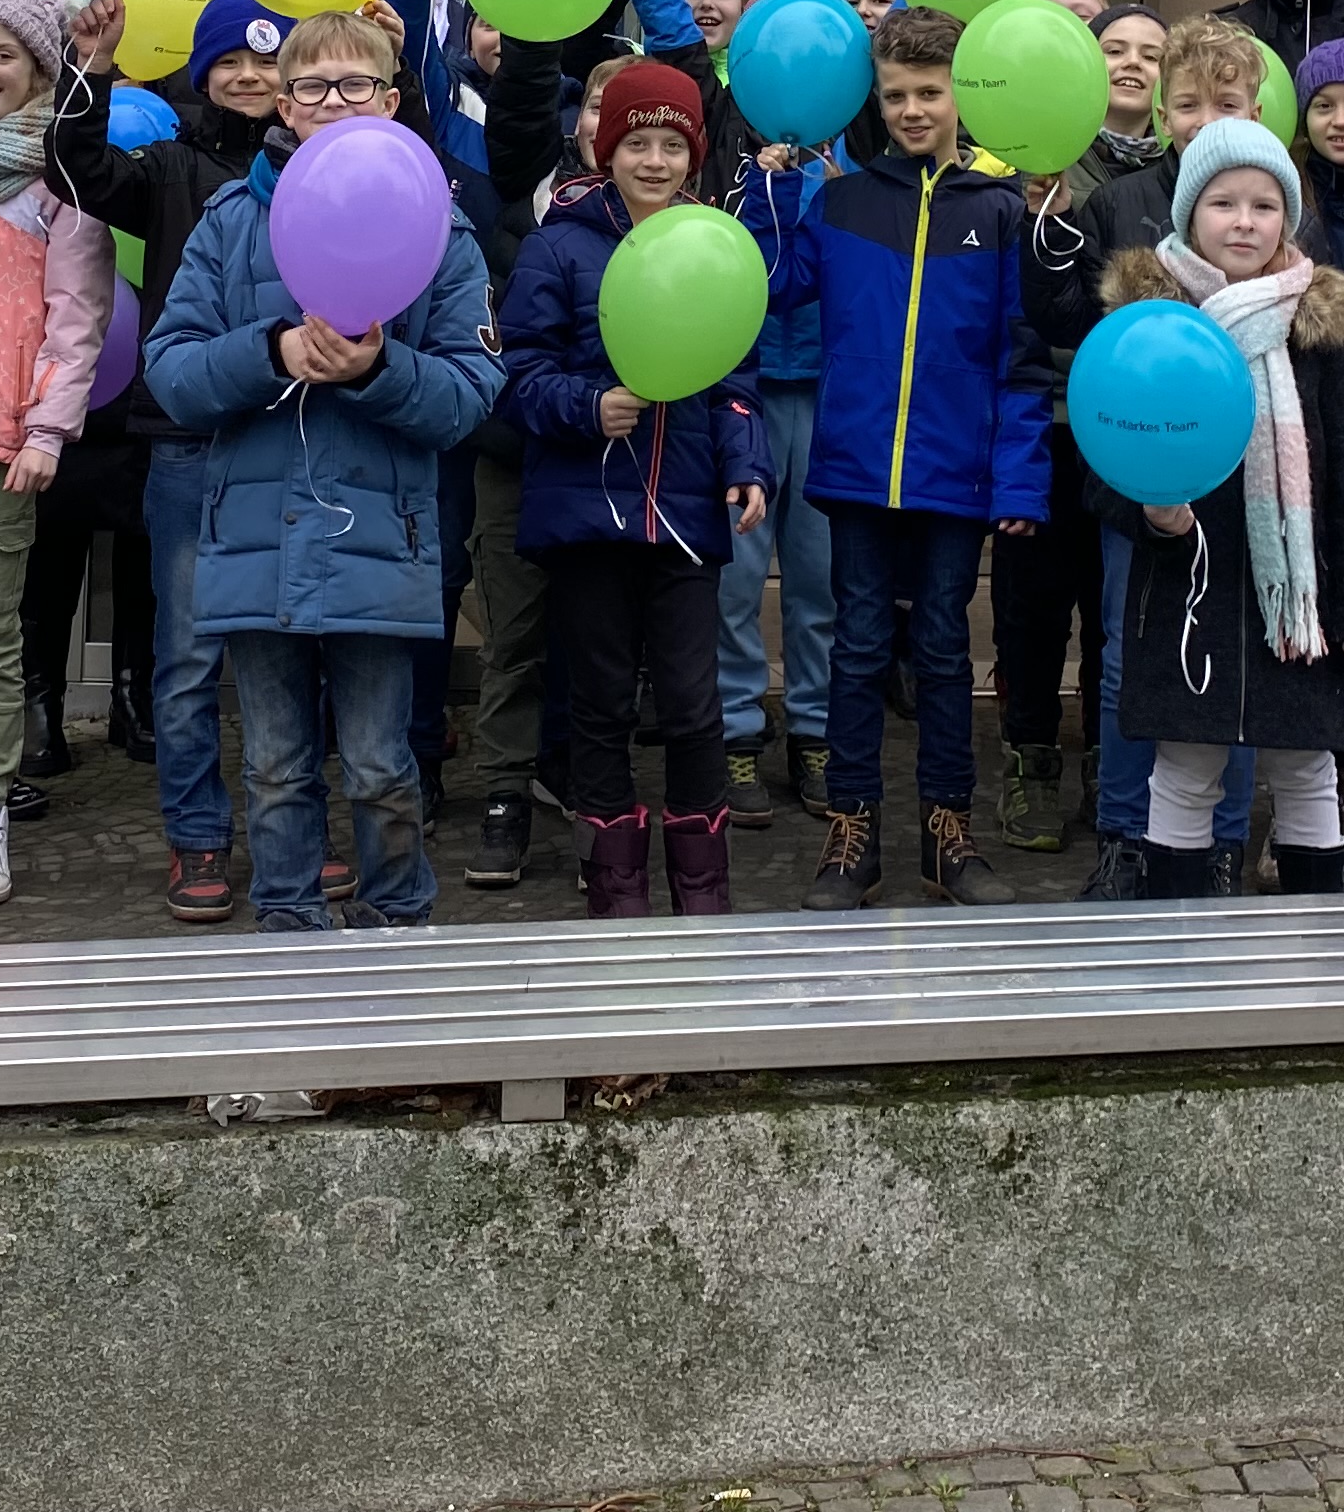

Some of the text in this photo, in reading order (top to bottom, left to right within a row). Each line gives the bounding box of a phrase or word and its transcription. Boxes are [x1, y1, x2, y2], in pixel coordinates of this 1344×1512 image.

[981, 78, 1007, 88] Team
[1097, 411, 1199, 433] Ein starkes Team
